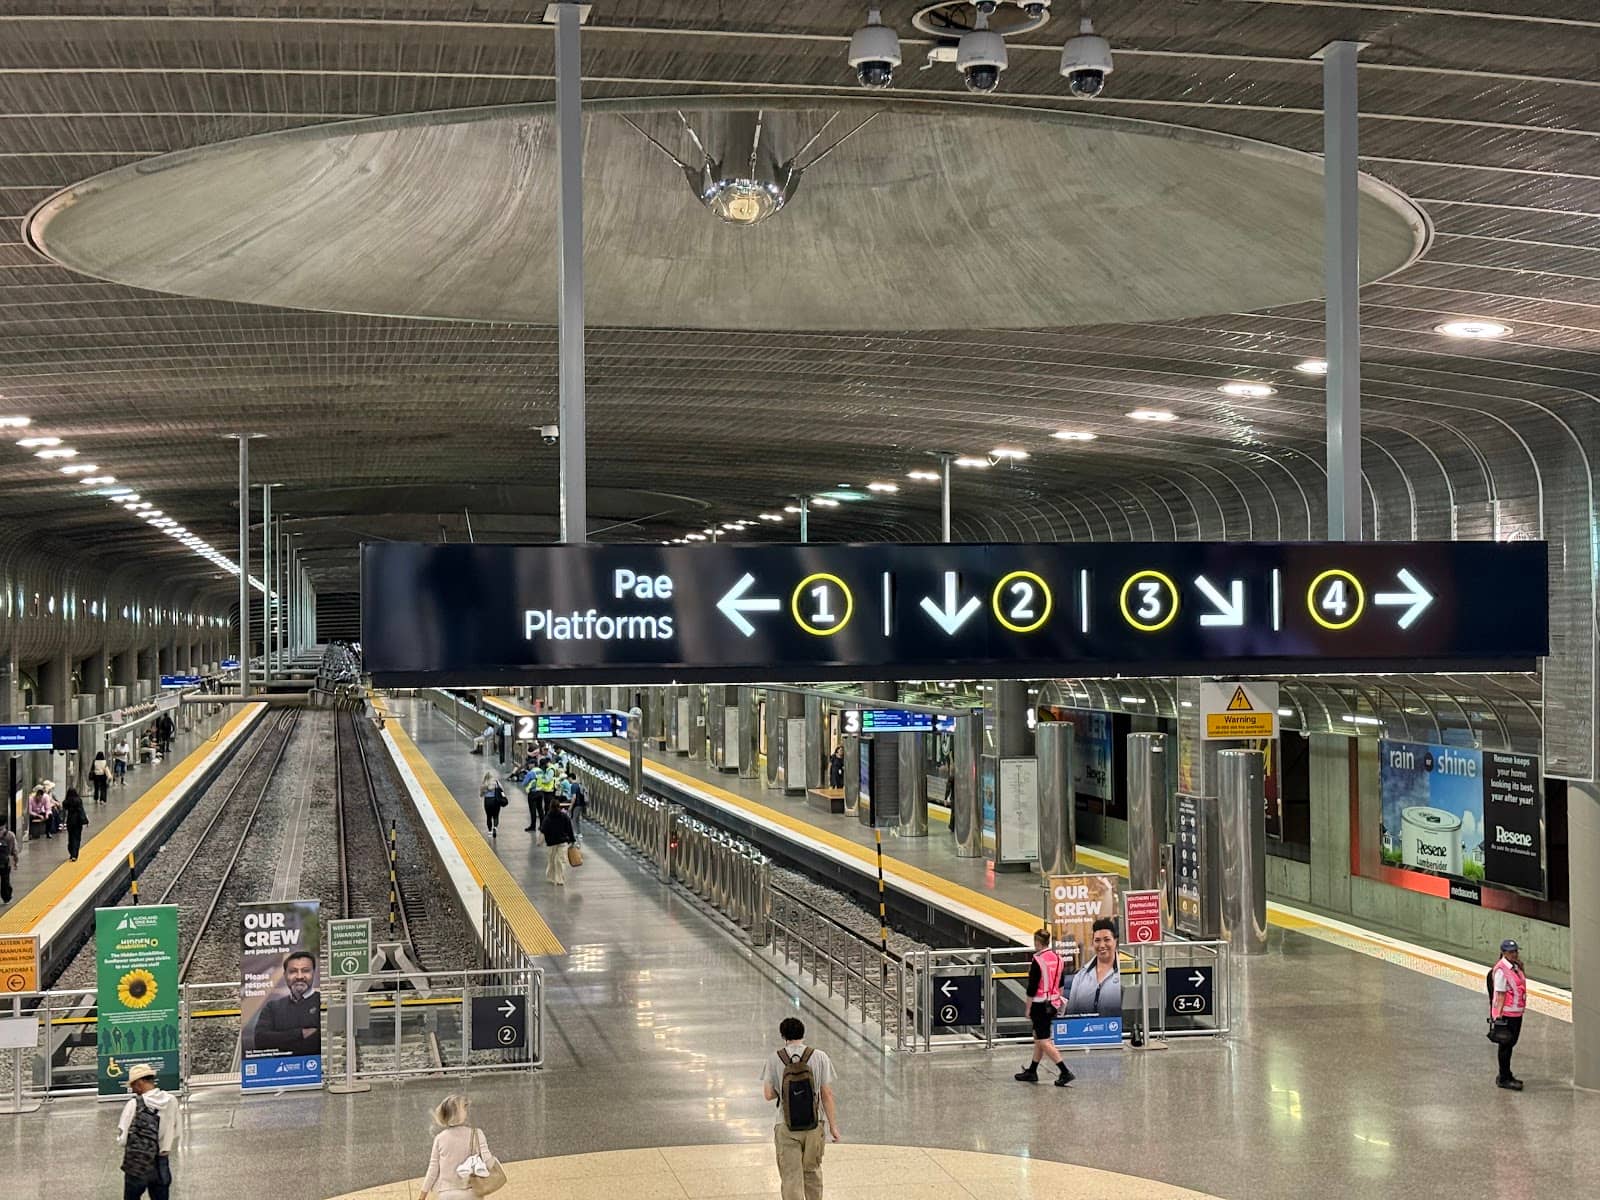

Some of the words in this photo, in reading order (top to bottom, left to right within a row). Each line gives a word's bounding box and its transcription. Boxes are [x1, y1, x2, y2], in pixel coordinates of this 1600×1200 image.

[615, 569, 673, 599] Pae
[811, 585, 835, 622] 1
[1010, 582, 1034, 619] 2
[1137, 582, 1161, 619] 3
[1322, 580, 1347, 616] 4
[525, 609, 673, 640] Platforms
[518, 716, 534, 738] 2
[845, 711, 859, 732] 3
[1224, 715, 1256, 724] Warning
[1390, 746, 1414, 770] rain
[1438, 748, 1476, 777] shine
[1494, 754, 1512, 764] Resene
[1514, 756, 1530, 767] keeps
[1497, 768, 1510, 777] your
[1510, 768, 1527, 778] home
[1491, 778, 1511, 791] looking
[1491, 794, 1504, 802] year
[1504, 793, 1518, 803] after
[1496, 826, 1532, 846] Resene
[1416, 838, 1447, 856] Resene
[1054, 886, 1089, 900] OUR
[1055, 901, 1102, 916] CREW
[244, 912, 285, 929] OUR
[244, 929, 300, 947] CREW
[245, 981, 273, 989] respect
[1179, 998, 1200, 1009] 3-4
[946, 1008, 952, 1019] 2
[503, 1029, 511, 1040] 2
